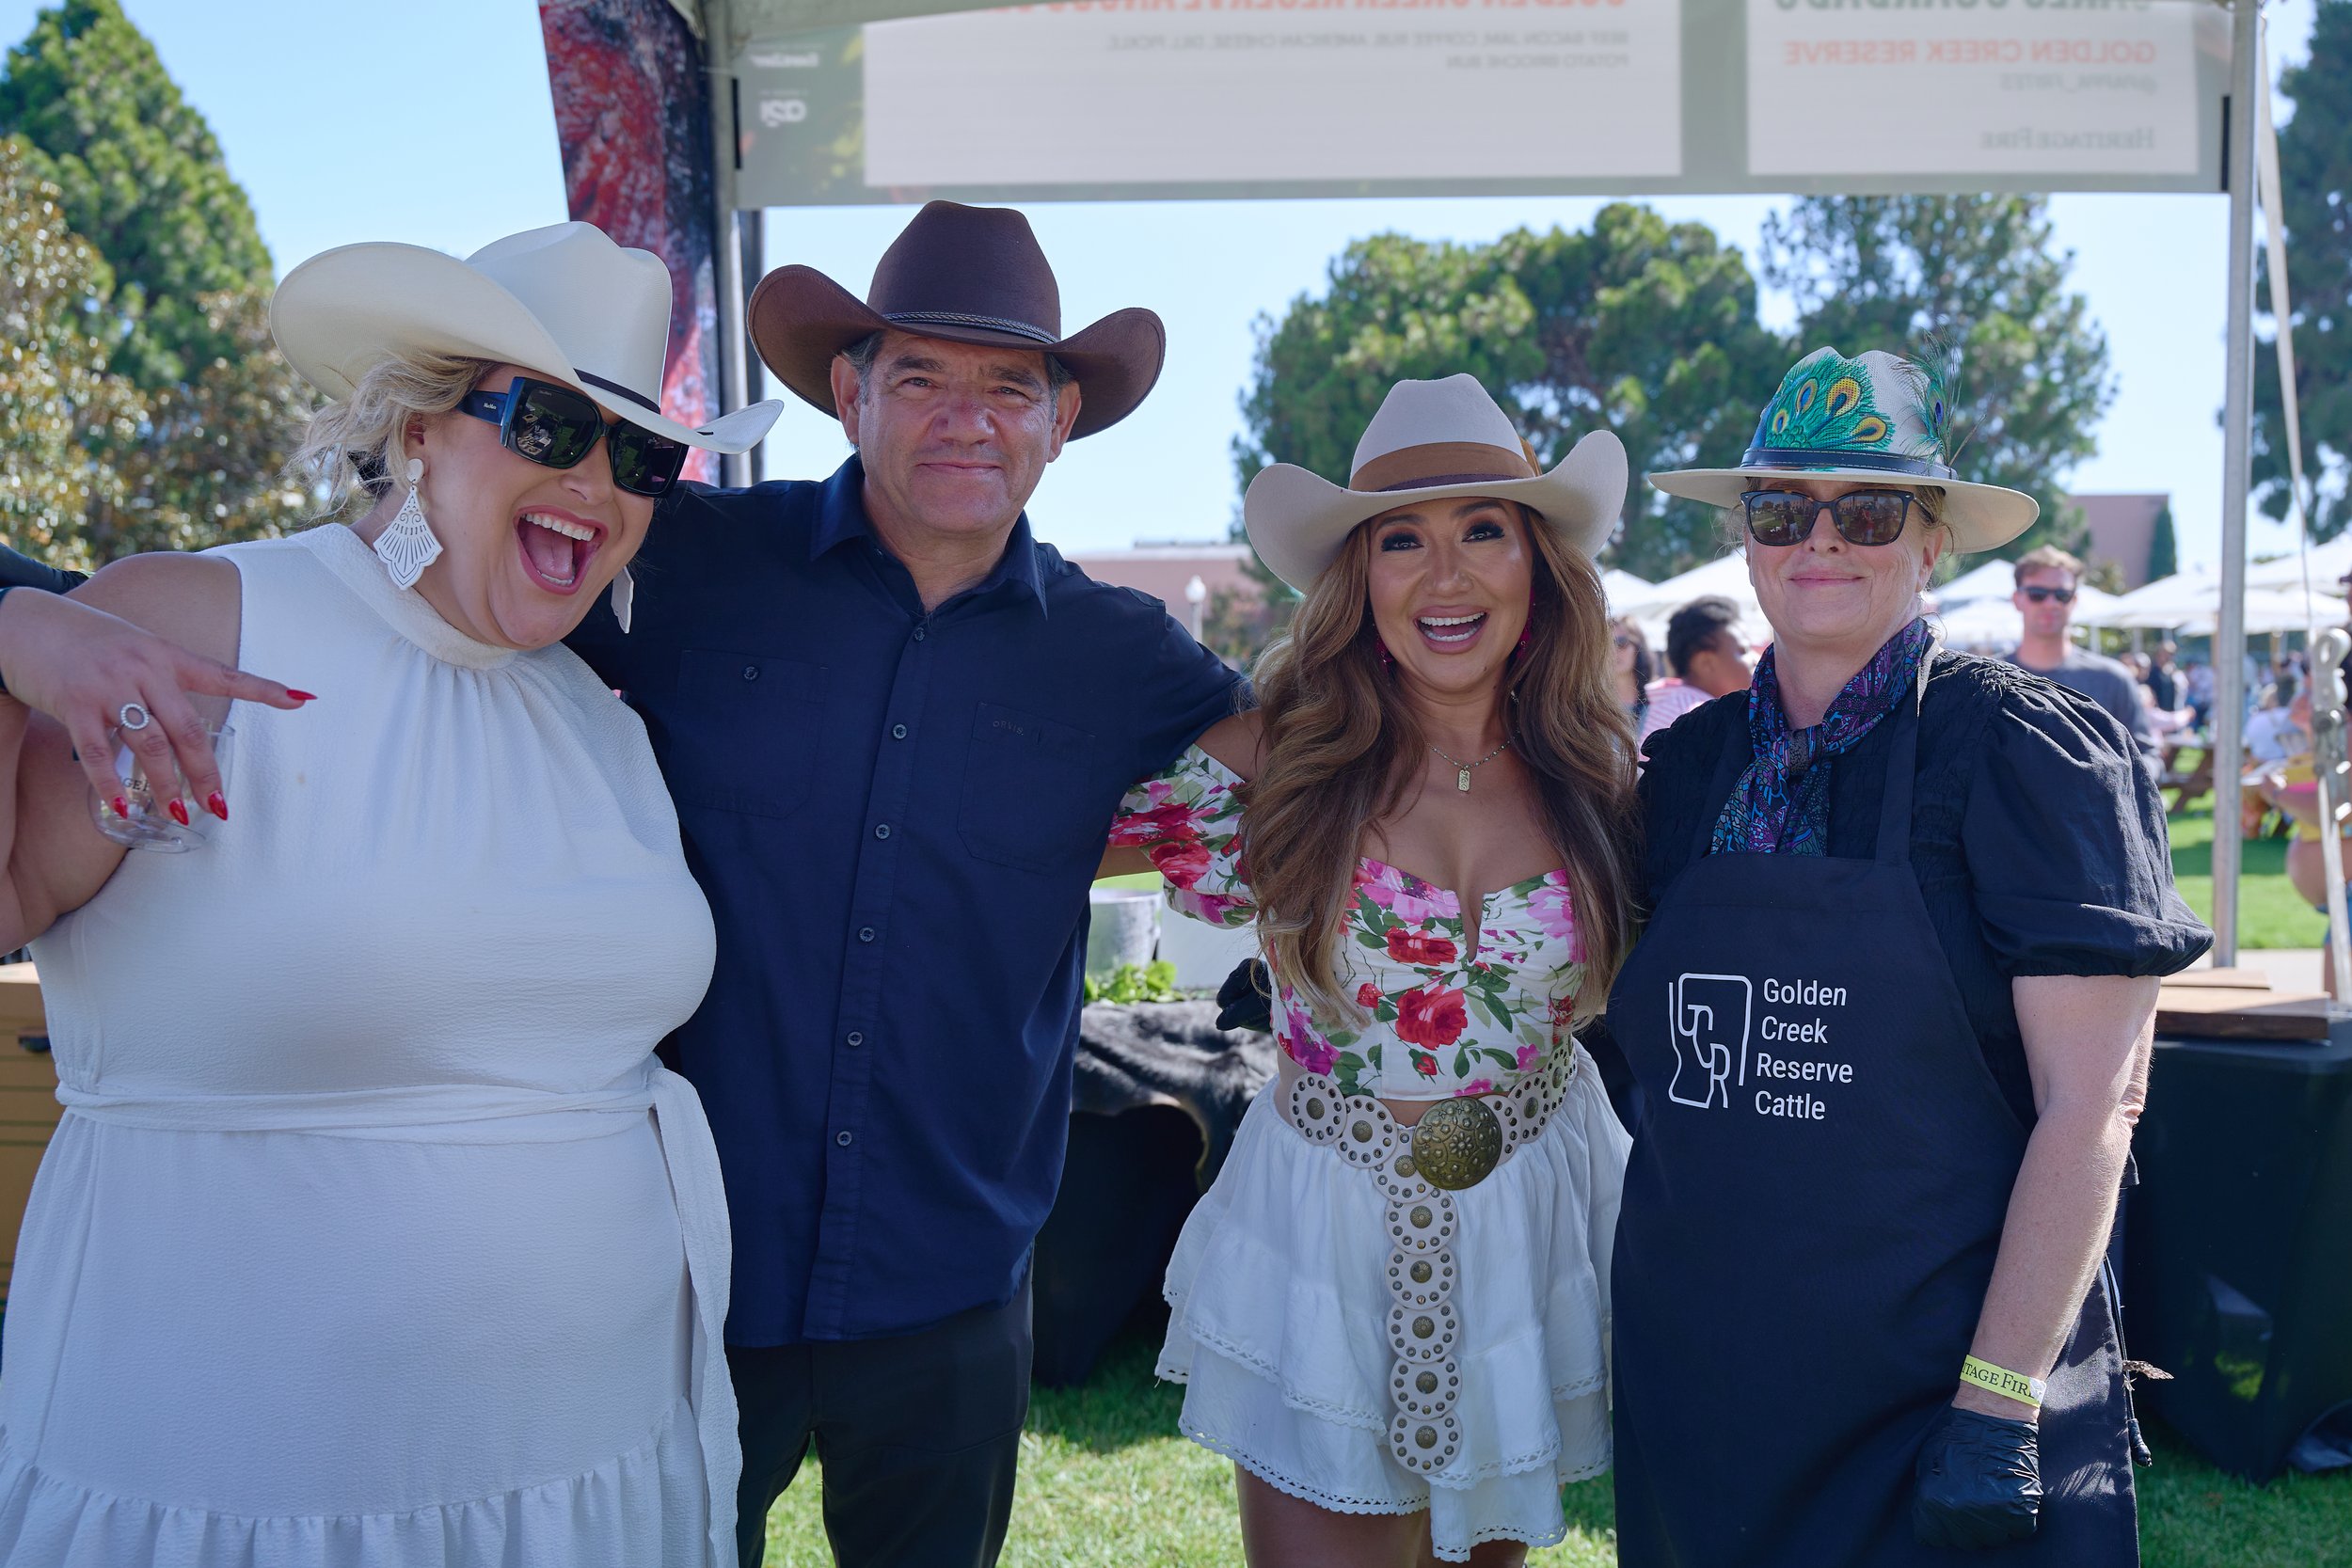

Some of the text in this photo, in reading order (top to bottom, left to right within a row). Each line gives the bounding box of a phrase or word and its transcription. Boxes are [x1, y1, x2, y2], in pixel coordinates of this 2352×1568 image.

[1763, 978, 1847, 1006] Golden
[1761, 1015, 1828, 1044] Creek
[1756, 1052, 1853, 1084] Reserve
[1755, 1090, 1826, 1120] Cattle
[2000, 1372, 2035, 1399] FIR
